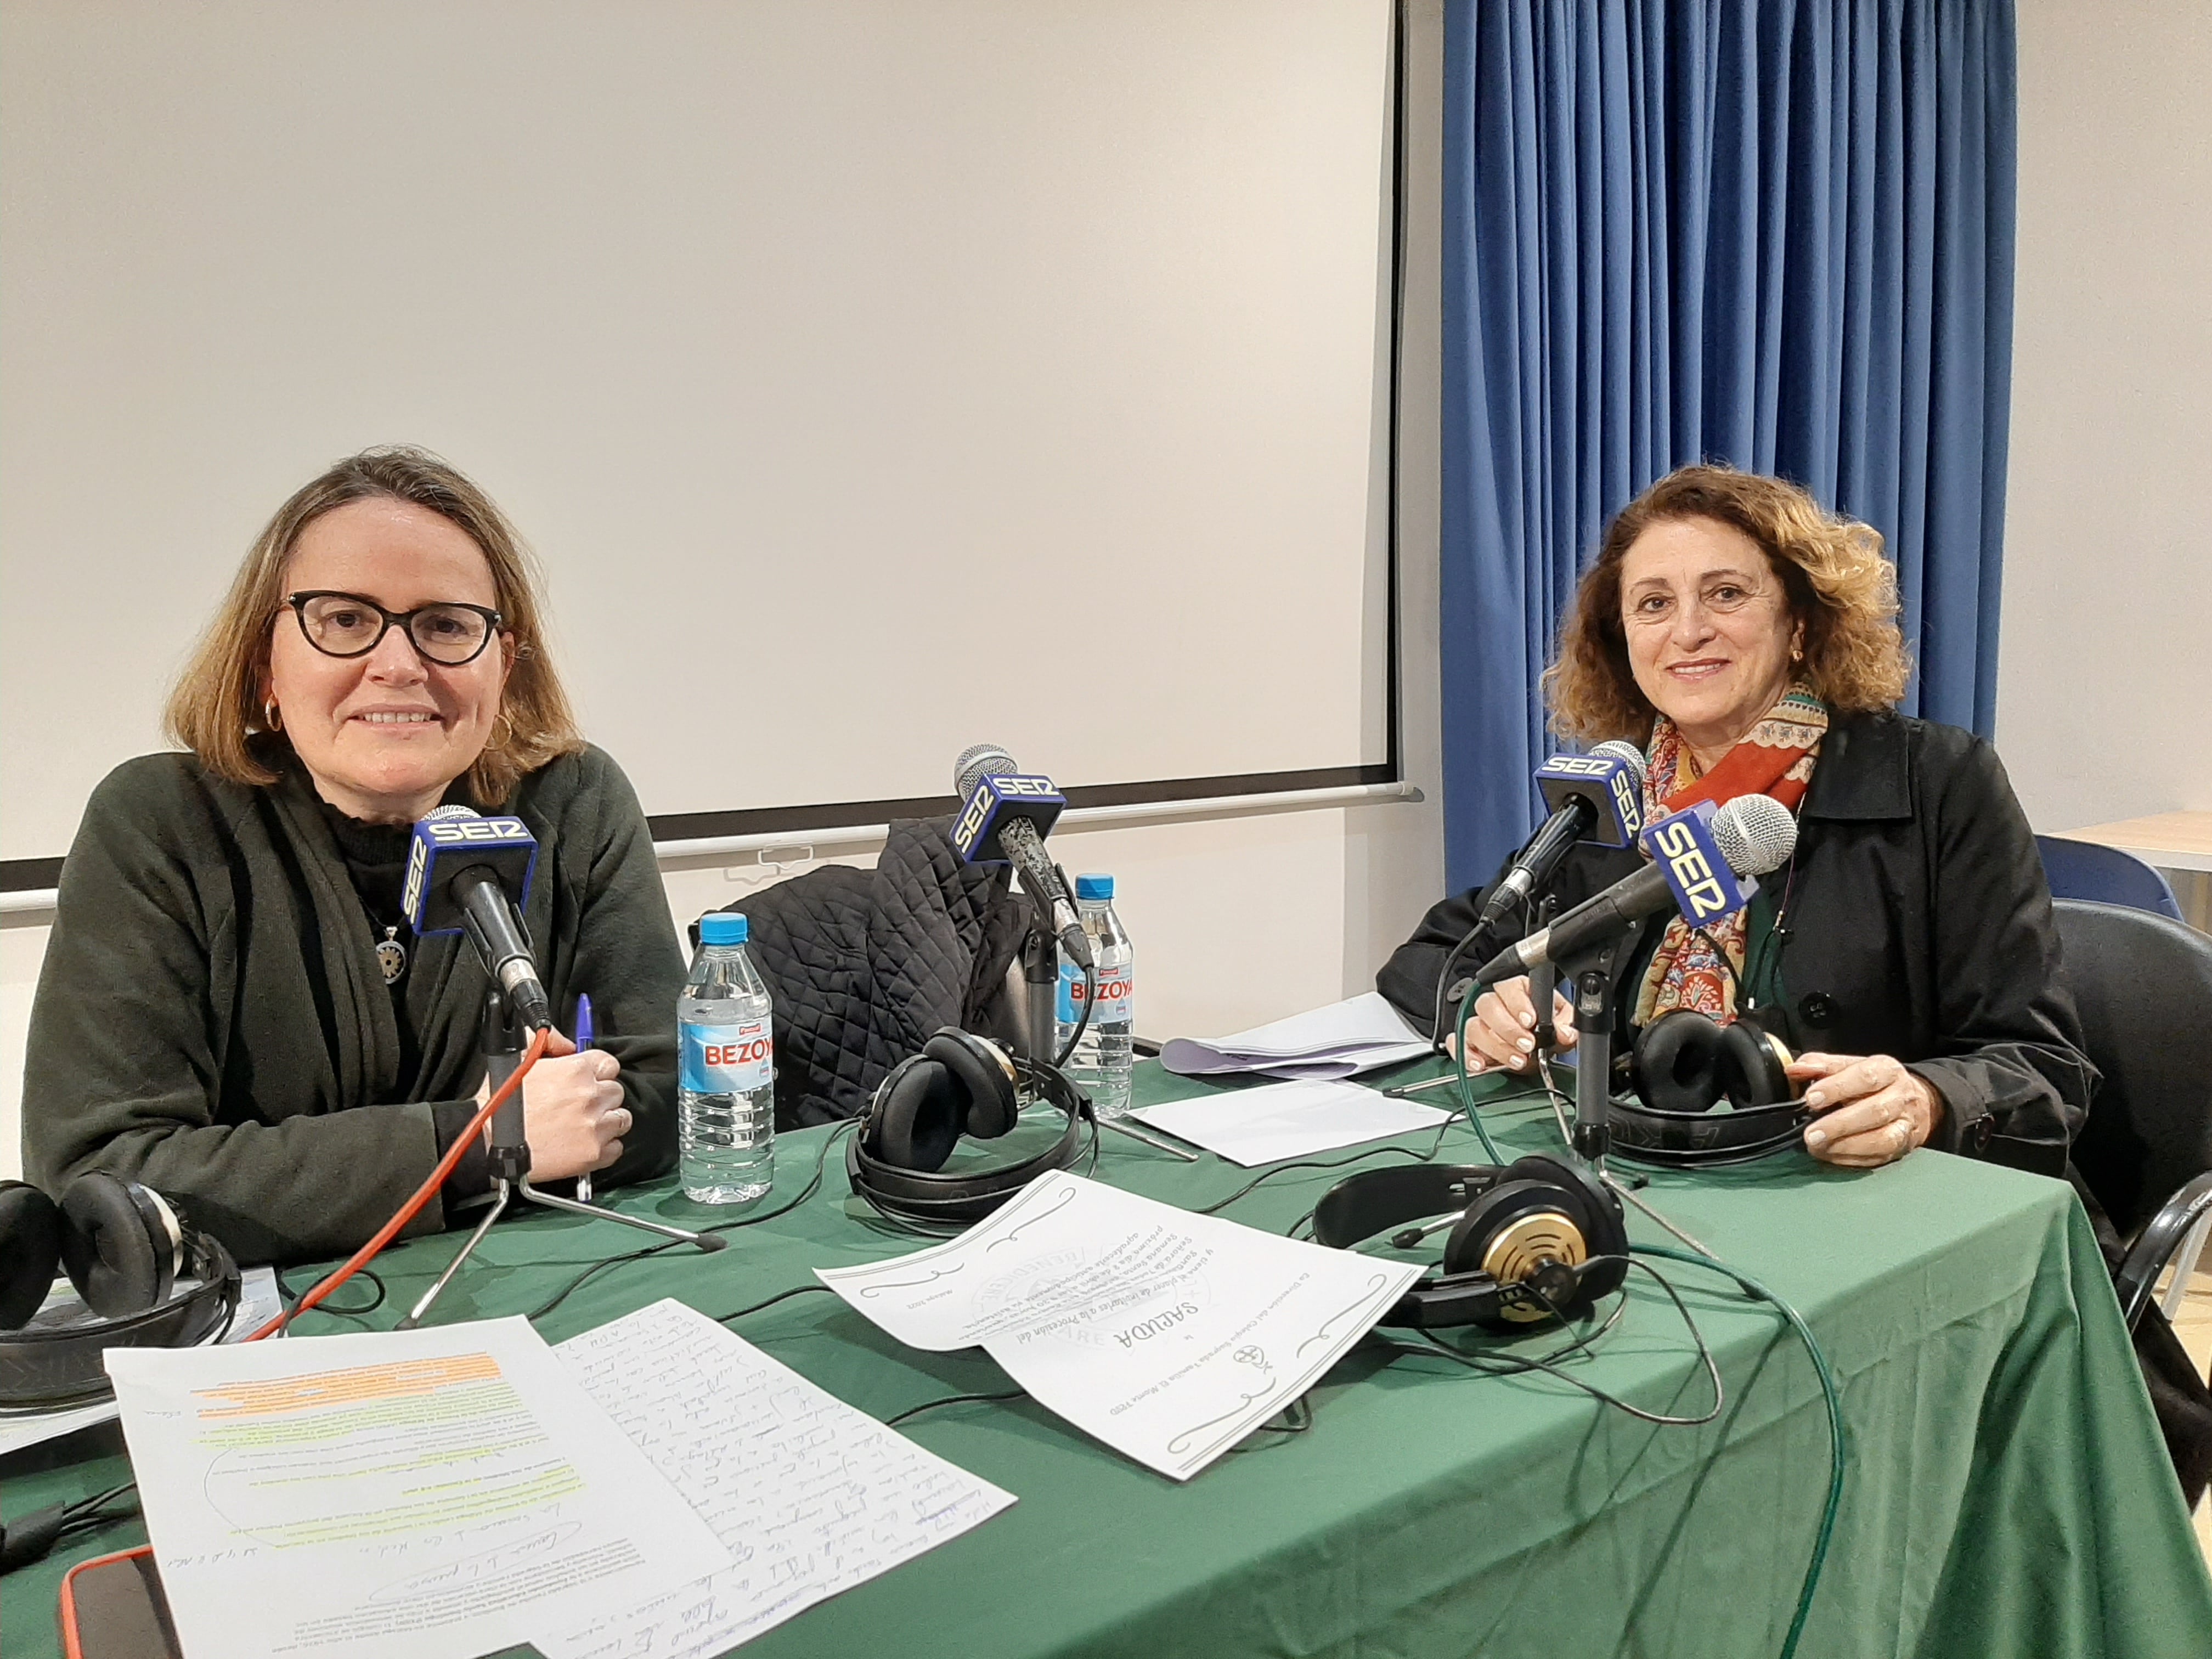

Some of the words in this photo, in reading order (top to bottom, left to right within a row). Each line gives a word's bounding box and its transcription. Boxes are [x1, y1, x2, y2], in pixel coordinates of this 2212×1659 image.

[1541, 757, 1613, 775] SER
[992, 777, 1060, 796] SER
[1610, 770, 1641, 839] SER
[428, 821, 529, 840] SER
[954, 785, 994, 853] SER
[403, 836, 426, 920] SER
[1654, 821, 1726, 919] SER
[1131, 1225, 1163, 1257] próximo
[1146, 1233, 1177, 1260] Semana
[1164, 1237, 1192, 1265] Señora
[1098, 1288, 1141, 1311] invitarles
[1032, 1314, 1080, 1336] Procesión
[1078, 1308, 1092, 1320] la
[1113, 1302, 1198, 1348] SALUDA
[1016, 1331, 1031, 1345] del
